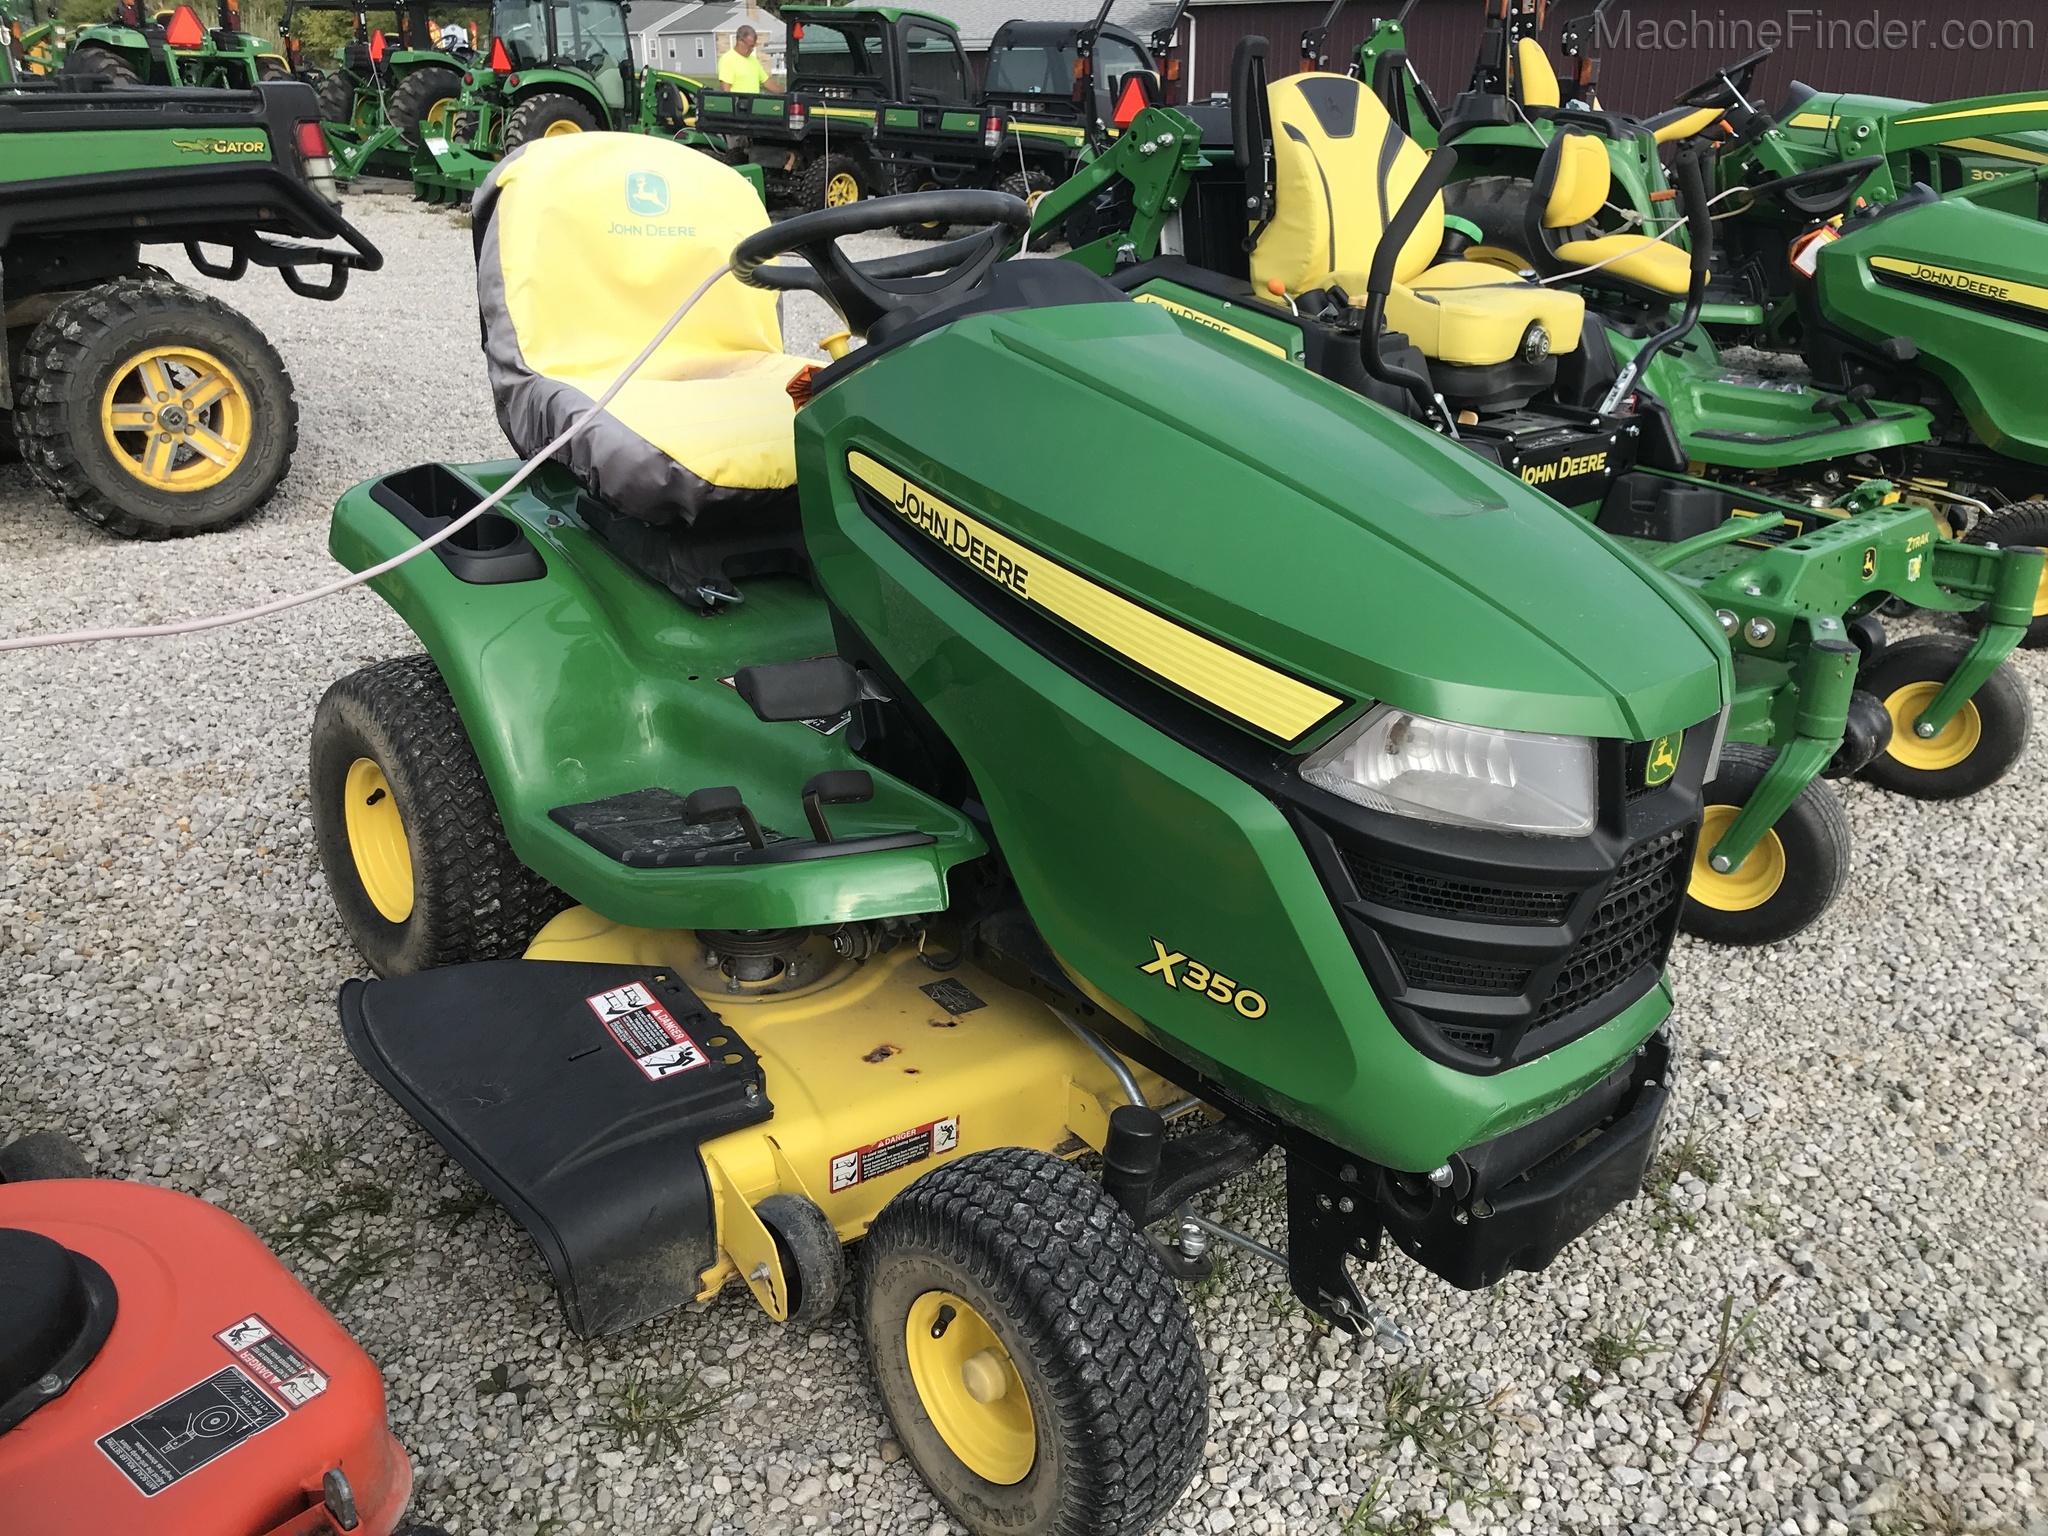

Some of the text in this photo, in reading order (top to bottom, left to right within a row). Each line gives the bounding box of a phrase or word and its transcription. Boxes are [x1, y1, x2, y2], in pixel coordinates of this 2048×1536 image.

[213, 140, 265, 154] GATOR
[607, 221, 697, 237] JOHN DEERE
[1910, 265, 2010, 299] JOHN DEERE
[1559, 451, 1608, 479] DEERE
[895, 482, 1030, 598] JOHN DEERE
[1905, 531, 1930, 553] ZTRAK
[1137, 936, 1268, 1020] X350
[657, 1014, 686, 1040] DANGER
[885, 1129, 916, 1145] DANGER
[240, 1350, 273, 1379] DANGER
[104, 1438, 158, 1491] ANTI-SCALP ROLLER SETTING
